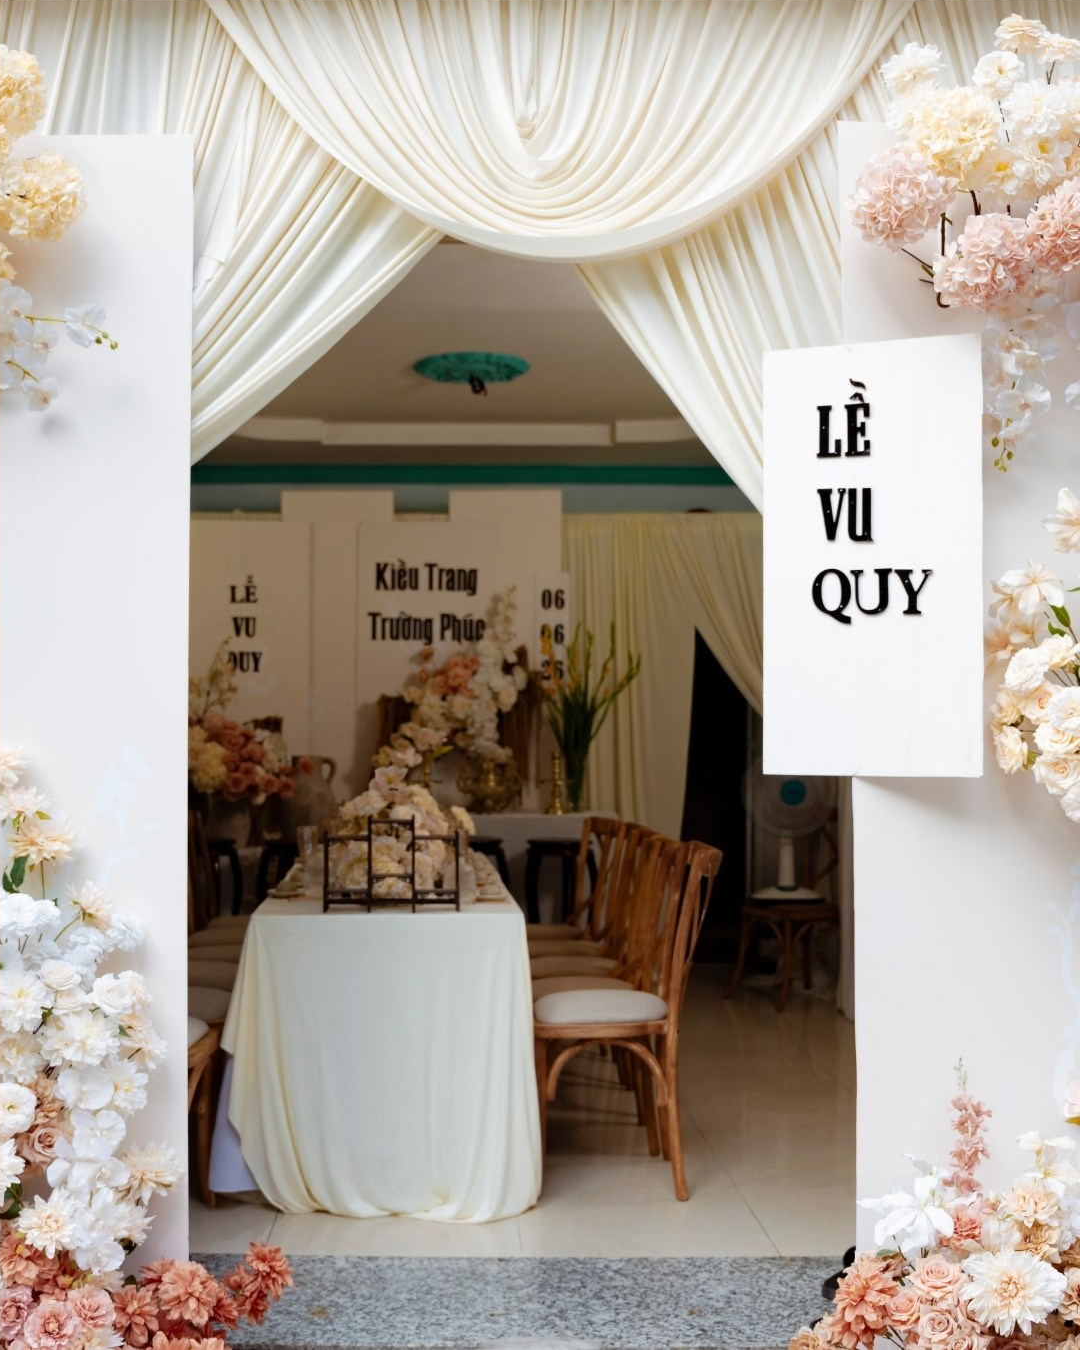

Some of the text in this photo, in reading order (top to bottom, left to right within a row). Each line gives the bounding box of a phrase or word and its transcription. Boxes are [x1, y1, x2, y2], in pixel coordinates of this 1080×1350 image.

[816, 378, 871, 458] LỄ
[817, 487, 874, 542] VU
[375, 559, 478, 596] Kiều Trang
[541, 589, 565, 610] 06
[812, 568, 933, 625] QUY
[232, 616, 257, 638] VU
[367, 611, 486, 646] Trường Phúc
